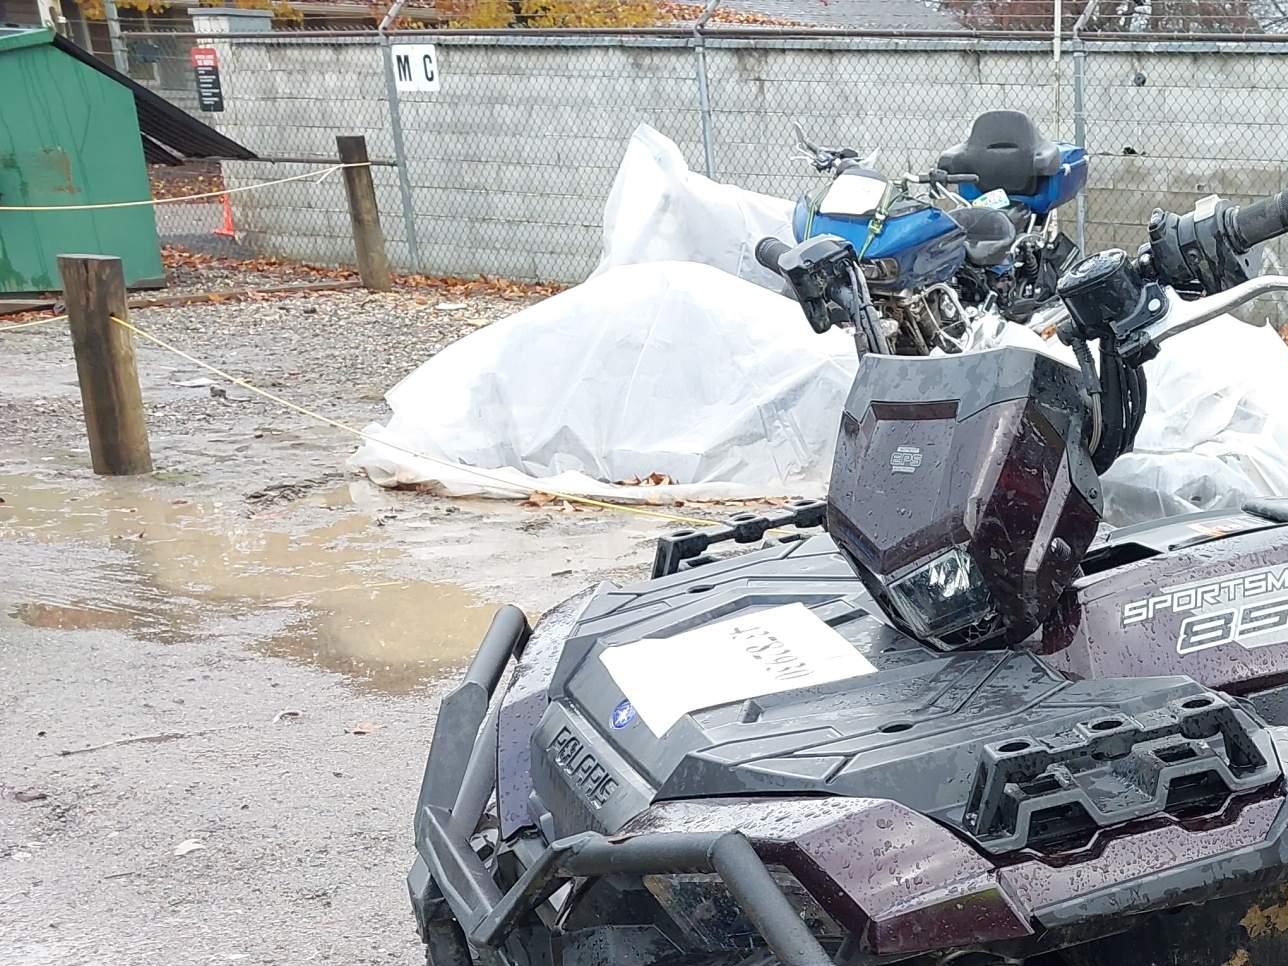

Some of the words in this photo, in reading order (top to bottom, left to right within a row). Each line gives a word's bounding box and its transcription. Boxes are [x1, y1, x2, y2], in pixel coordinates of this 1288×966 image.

[396, 54, 412, 82] M
[423, 54, 434, 82] C
[546, 725, 619, 809] POLARIS
